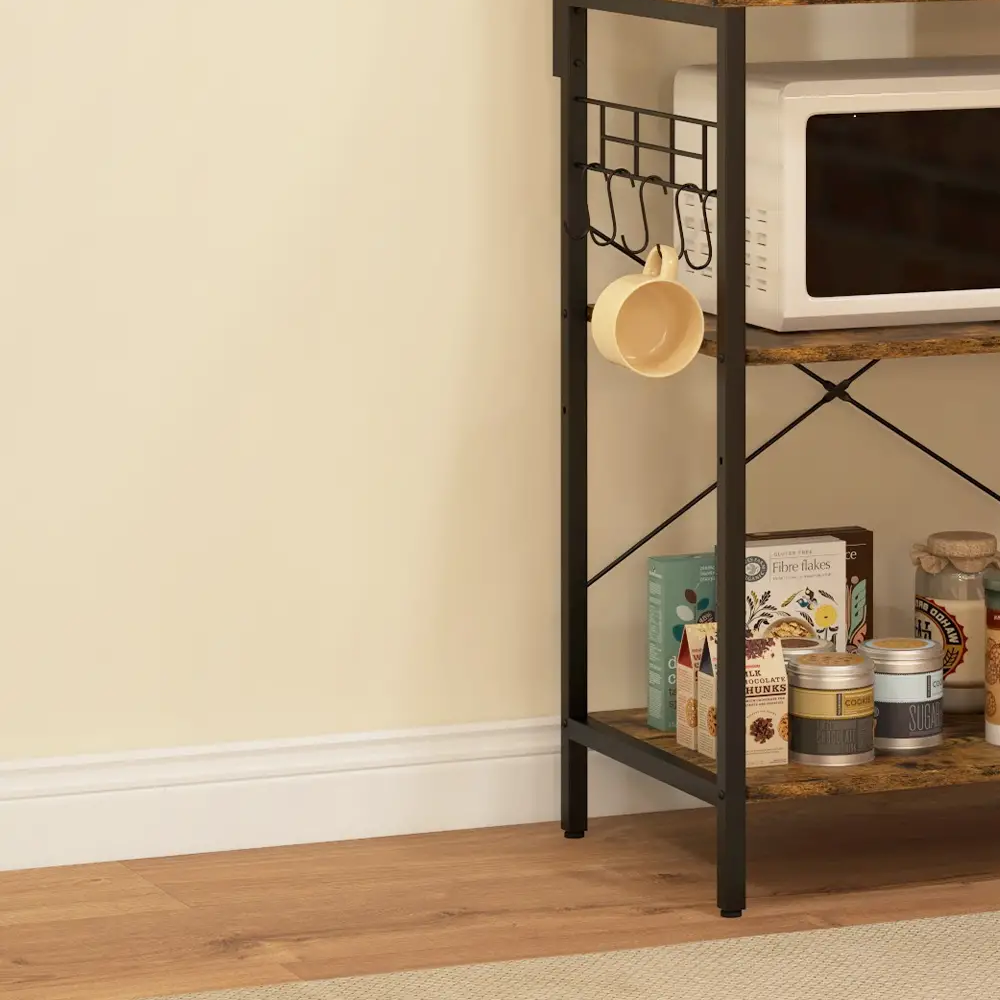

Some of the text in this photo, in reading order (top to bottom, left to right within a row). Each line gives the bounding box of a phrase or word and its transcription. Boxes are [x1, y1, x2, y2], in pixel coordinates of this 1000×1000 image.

[772, 558, 831, 573] Fibre flakes
[745, 676, 786, 684] OCOLATE
[746, 684, 786, 694] HUNKS
